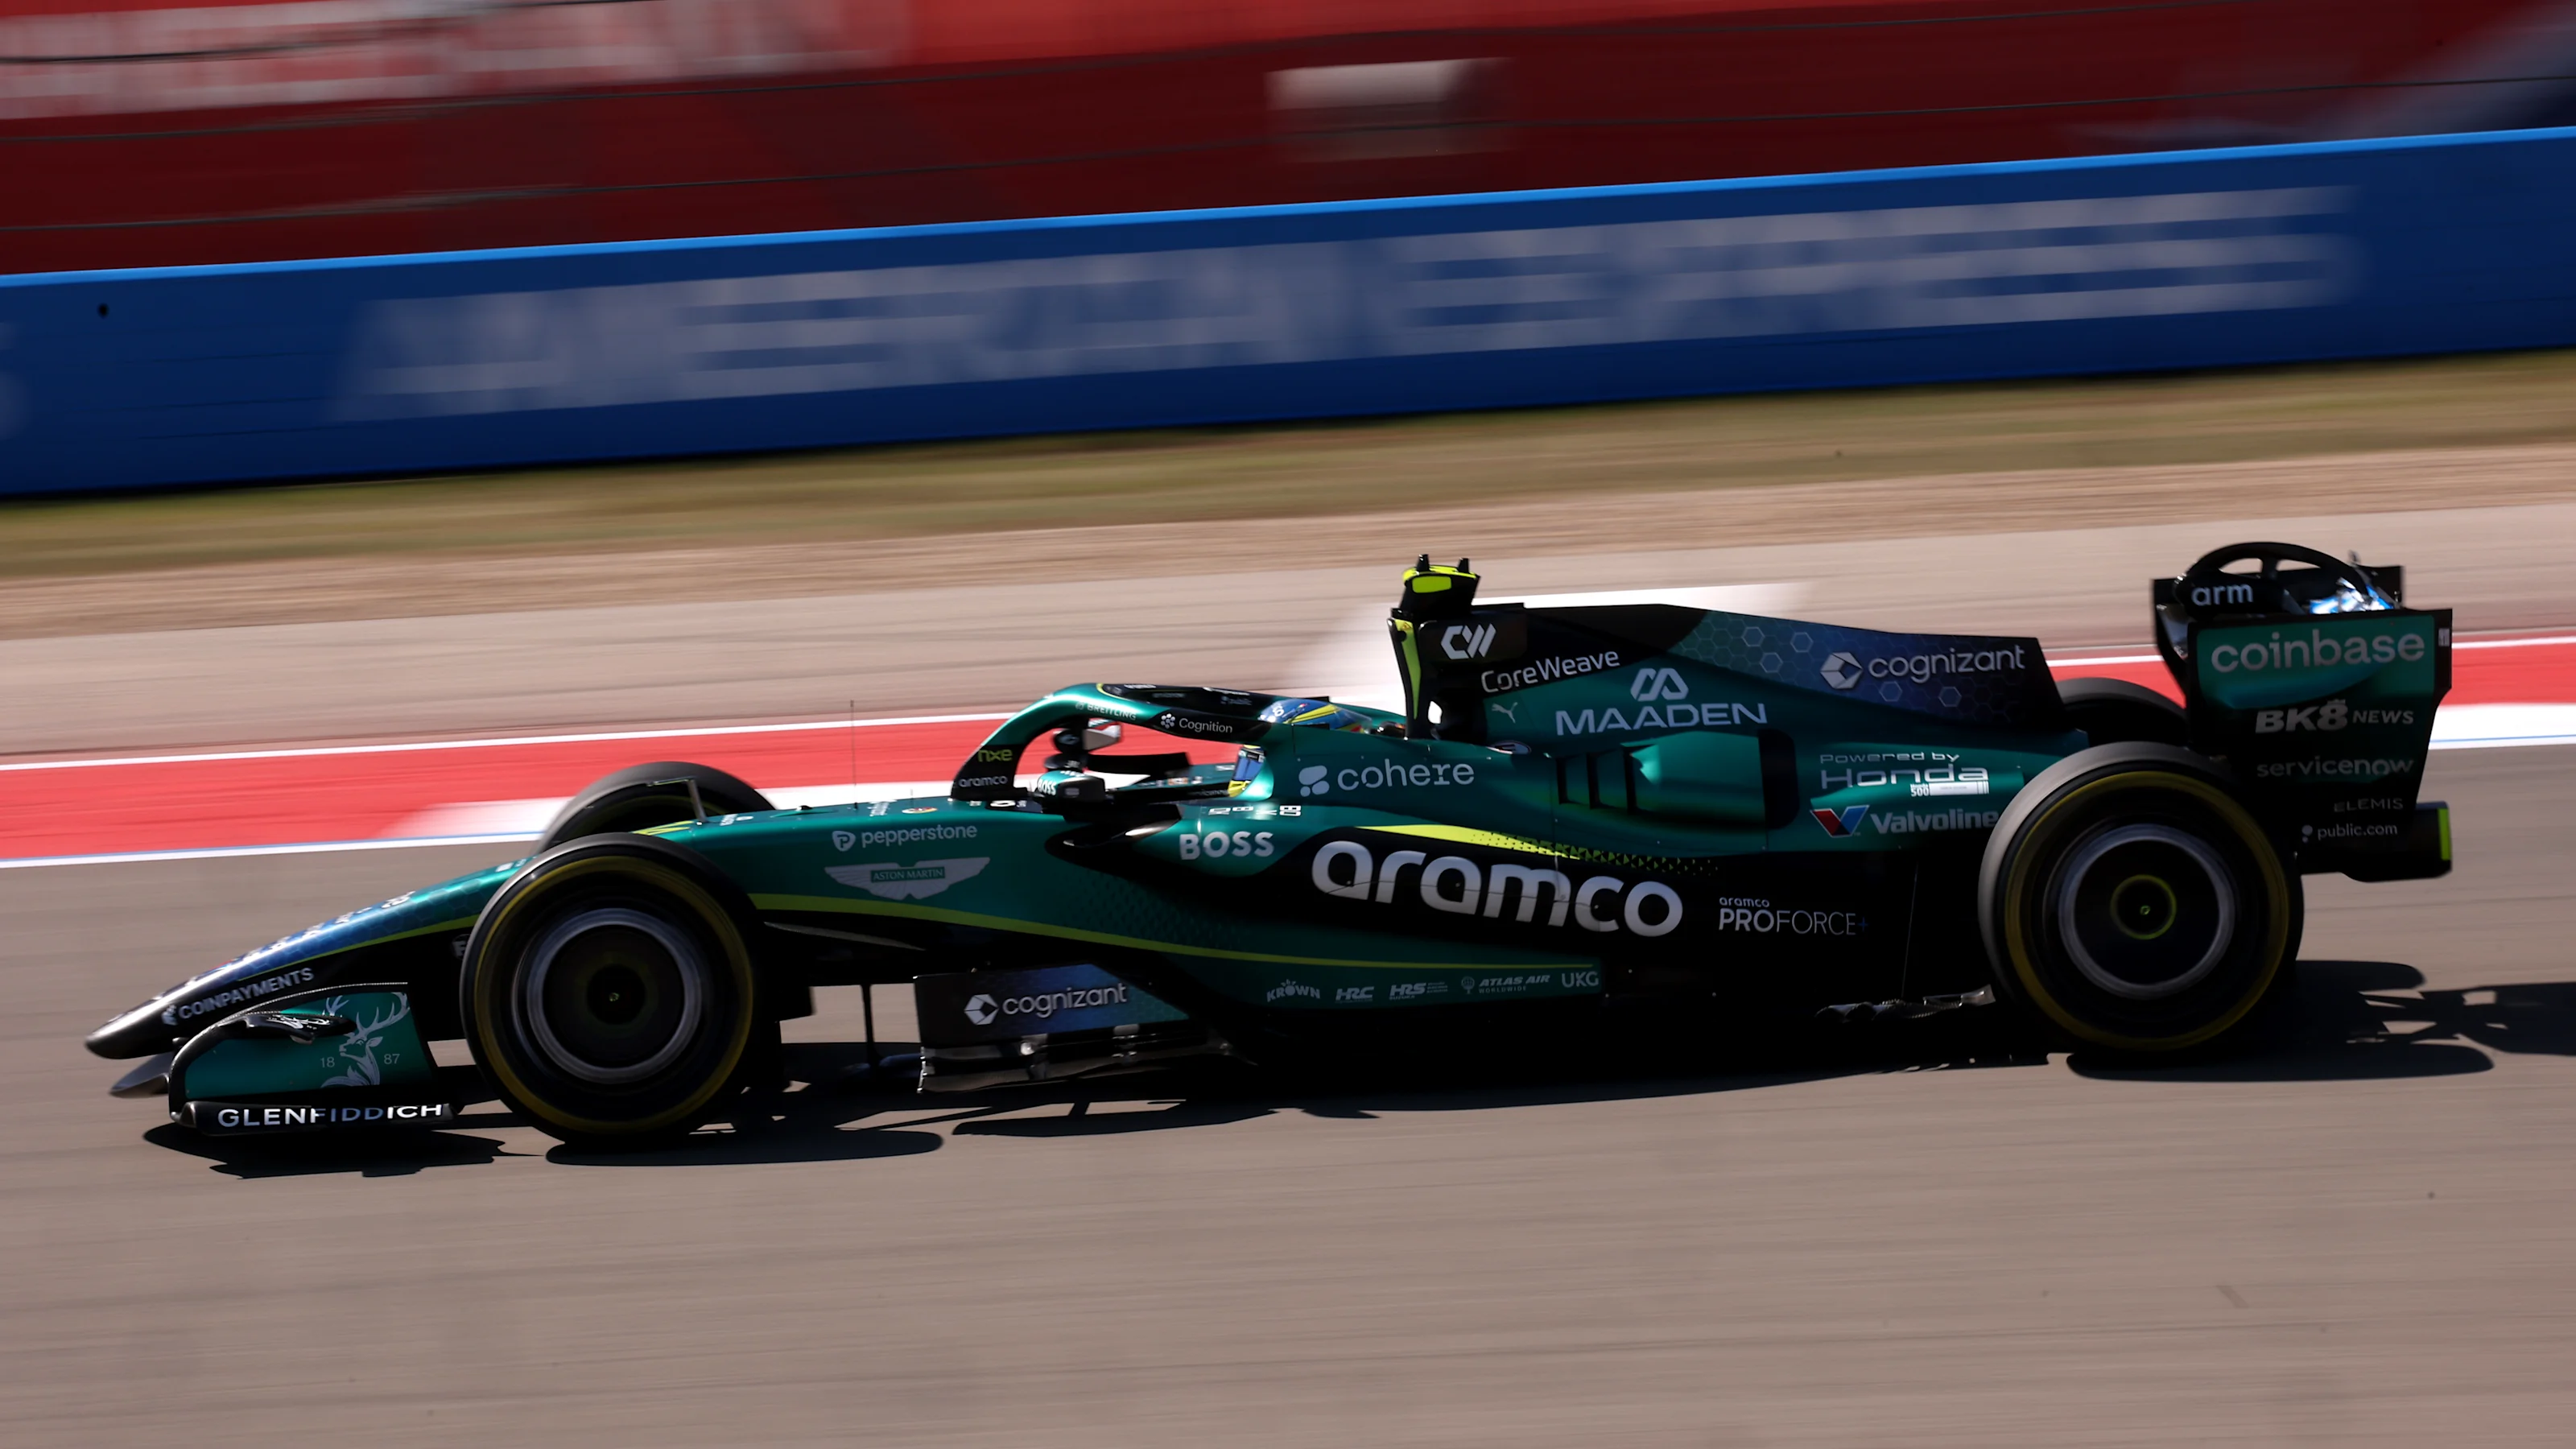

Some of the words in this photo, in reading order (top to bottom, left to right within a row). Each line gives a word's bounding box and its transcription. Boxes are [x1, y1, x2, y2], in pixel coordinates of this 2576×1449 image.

[2191, 583, 2254, 606] arm
[2211, 629, 2425, 673] coinbase
[1481, 650, 1620, 694] CoreWeave
[1868, 645, 2025, 683] cognizant
[1087, 703, 1137, 721] BREITLING
[1556, 703, 1768, 736] MAADEN
[2255, 699, 2349, 733] BK8
[2352, 709, 2414, 724] NEWS
[1179, 718, 1233, 734] Cognition
[1820, 752, 1925, 764] Powered
[1932, 752, 1959, 762] by
[2256, 755, 2414, 778] servicenow
[959, 776, 1008, 787] aramco
[1337, 758, 1475, 791] cohere
[1821, 764, 1988, 789] Honda
[1038, 779, 1057, 795] BOSS
[1910, 787, 1929, 797] 500
[2334, 798, 2404, 813] ELEMIS
[1870, 809, 1999, 834] Valvoline
[861, 824, 978, 848] pepperstone
[2318, 823, 2397, 841] public.com
[1179, 831, 1275, 861] BOSS
[873, 869, 905, 881] ASTON
[906, 868, 943, 879] MARTIN
[1311, 840, 1683, 937] aramco
[1719, 897, 1769, 907] aramco
[1389, 982, 1426, 997] HRS
[1479, 976, 1524, 987] ATLAS
[1525, 974, 1550, 984] AIR
[1479, 985, 1527, 993] WORLDWIDE
[1561, 971, 1599, 989] UKG
[179, 967, 315, 1020] COINPAYMENTS
[1002, 983, 1128, 1018] cognizant
[1335, 986, 1375, 1001] HRC
[320, 1057, 335, 1068] 18
[383, 1053, 400, 1065] 87
[217, 1104, 443, 1127] GLENFIDDICH
